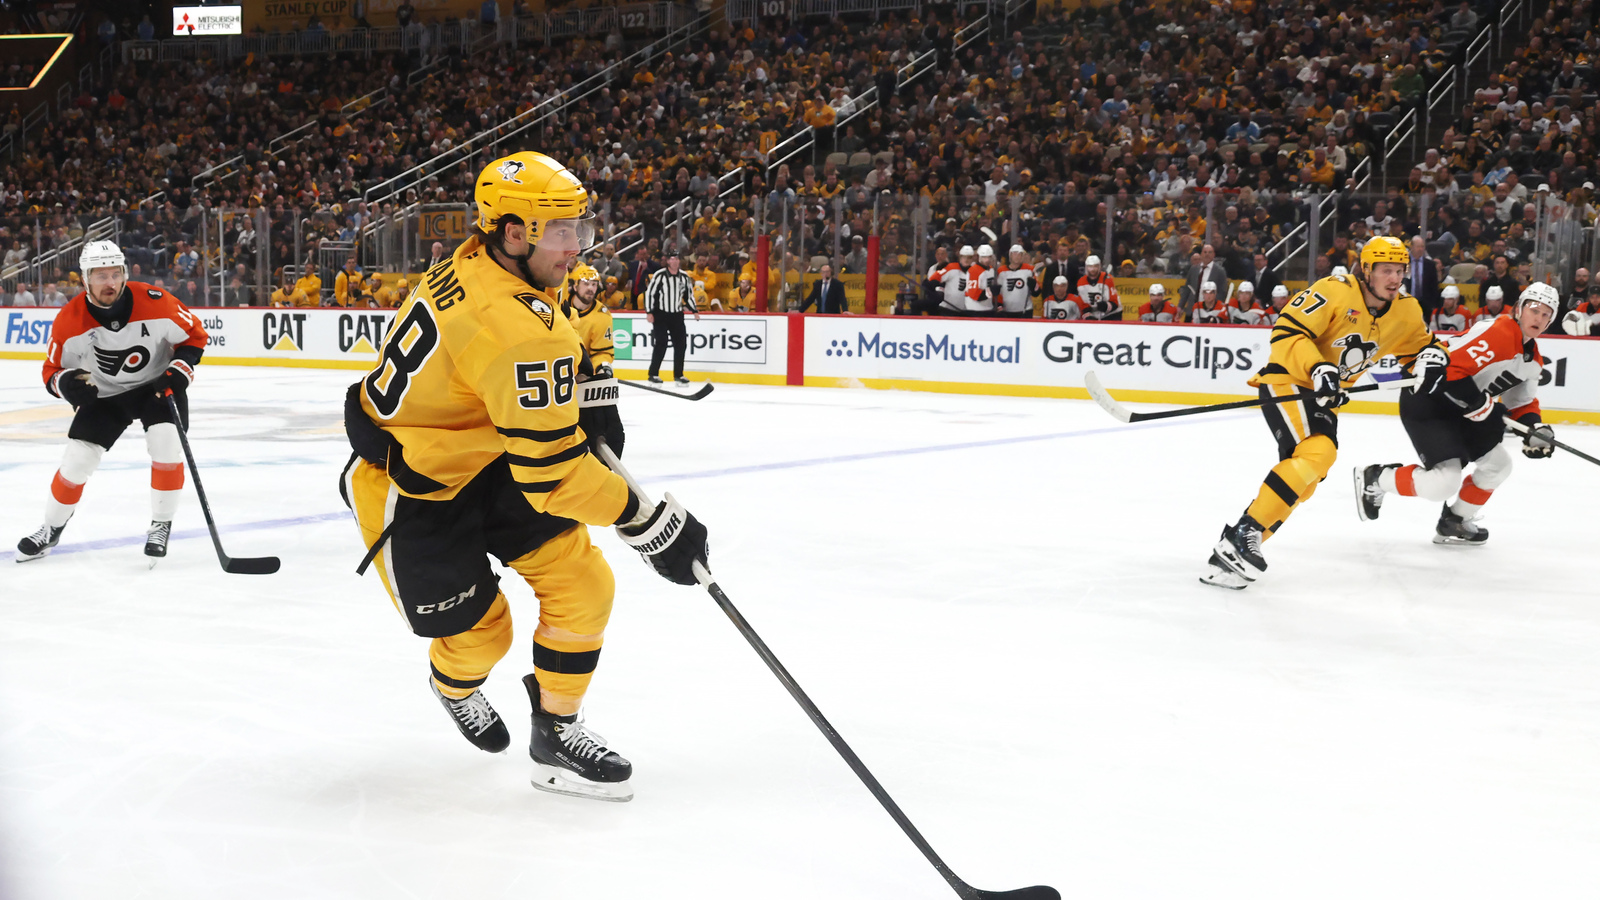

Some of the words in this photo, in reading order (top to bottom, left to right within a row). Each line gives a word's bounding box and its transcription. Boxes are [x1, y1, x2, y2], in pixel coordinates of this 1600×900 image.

[265, 2, 319, 16] STANLEY
[322, 1, 347, 13] CUP
[621, 9, 645, 28] 122
[762, 0, 785, 16] 101
[198, 23, 234, 31] ELECTRIC
[131, 48, 153, 60] 121
[427, 257, 466, 311] ANG
[1290, 290, 1328, 315] 67
[141, 323, 150, 337] A
[203, 315, 223, 330] sub
[263, 312, 306, 351] CAT
[338, 313, 385, 353] CAT
[858, 332, 1020, 364] MassMutual
[1043, 330, 1151, 367] Great
[1161, 335, 1253, 380] Clips
[1466, 340, 1496, 368] 22
[514, 355, 576, 409] 58
[416, 583, 477, 615] CCM
